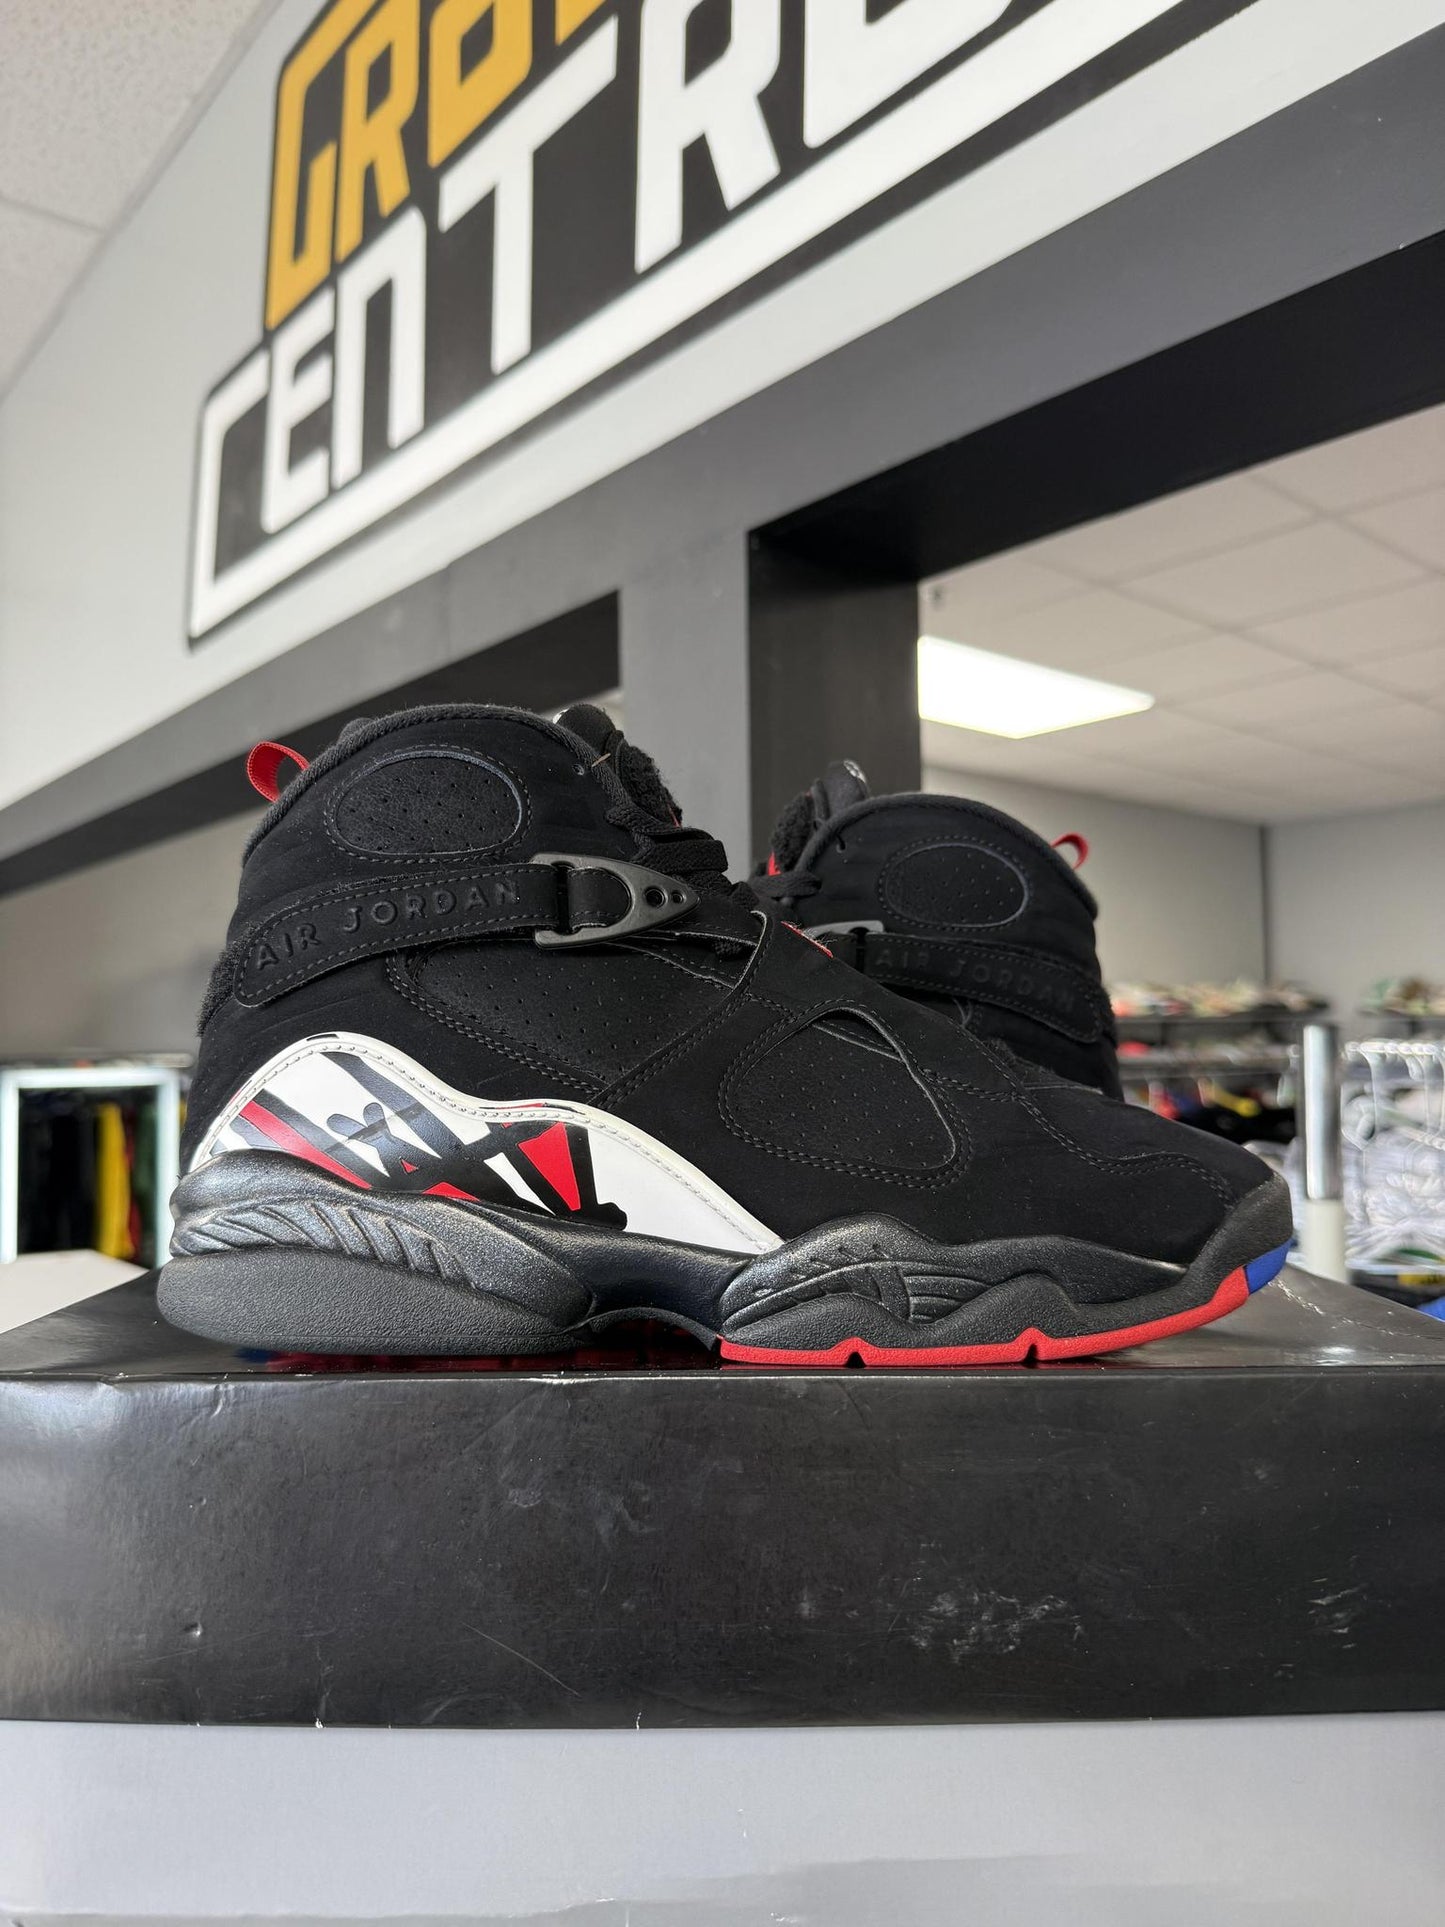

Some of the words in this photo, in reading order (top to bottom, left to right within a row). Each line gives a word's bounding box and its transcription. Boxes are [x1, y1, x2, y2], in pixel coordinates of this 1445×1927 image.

[264, 0, 601, 331] GRO
[256, 922, 321, 971] AIR
[342, 878, 522, 934] JORDAN
[874, 948, 930, 969] AIR
[948, 958, 1076, 1012] JORDAN
